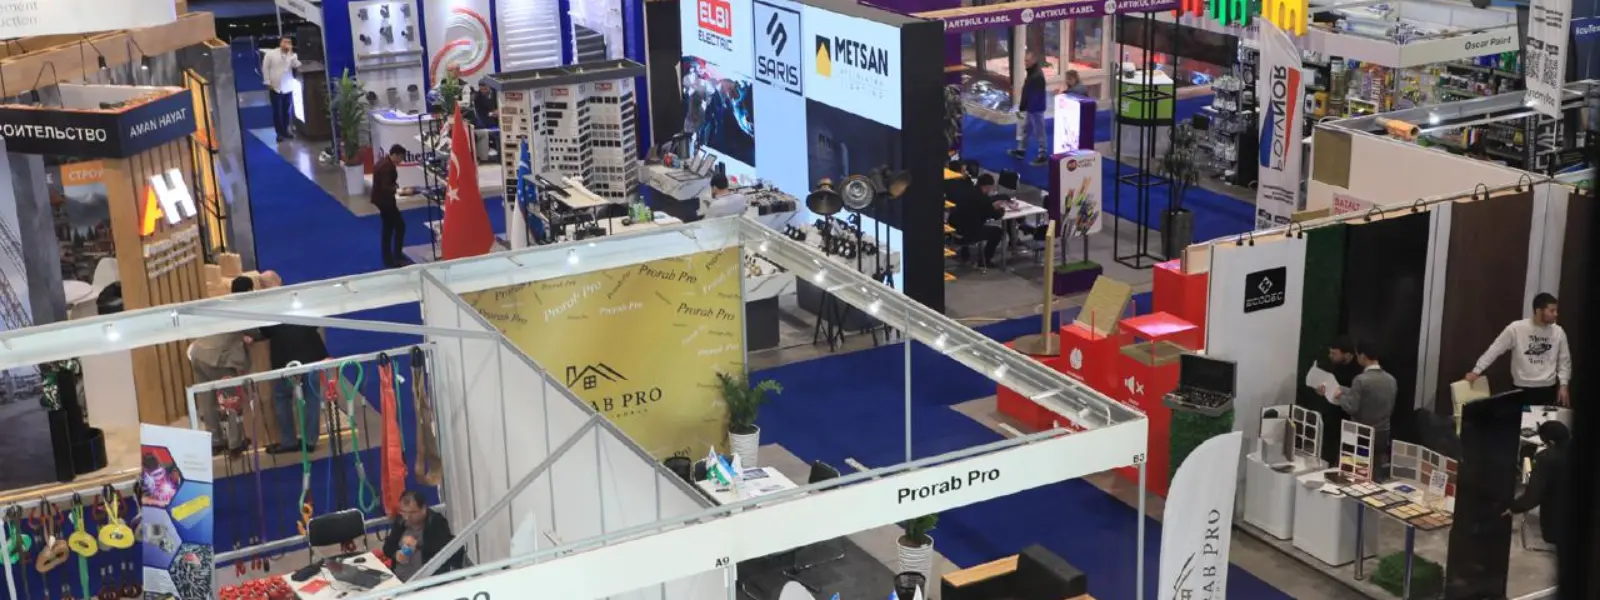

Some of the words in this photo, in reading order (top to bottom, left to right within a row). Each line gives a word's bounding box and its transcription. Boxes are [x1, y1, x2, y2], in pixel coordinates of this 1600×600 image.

[700, 0, 729, 29] ELBI
[948, 17, 982, 29] ARTIKUL
[984, 14, 1011, 24] KABEL
[1035, 8, 1068, 19] ARTIKUL
[1070, 5, 1095, 14] KABEL
[698, 30, 732, 51] ELECTRIC
[1464, 39, 1488, 51] Oscar
[1490, 36, 1512, 46] Paint
[834, 35, 889, 77] METSAN
[758, 55, 799, 86] SARIS
[0, 123, 107, 142] ОИТЕЛЬСТВО
[129, 119, 157, 138] AMAN
[159, 107, 187, 128] HAYAT
[638, 264, 676, 281] Prorab
[678, 270, 697, 285] Pro
[677, 302, 714, 318] Prorab
[716, 307, 736, 321] Pro
[622, 387, 662, 408] PRO
[1133, 453, 1145, 464] B3
[898, 475, 962, 504] Prorab
[968, 468, 1000, 486] Pro
[1203, 509, 1221, 555] PRO
[715, 556, 730, 567] A9
